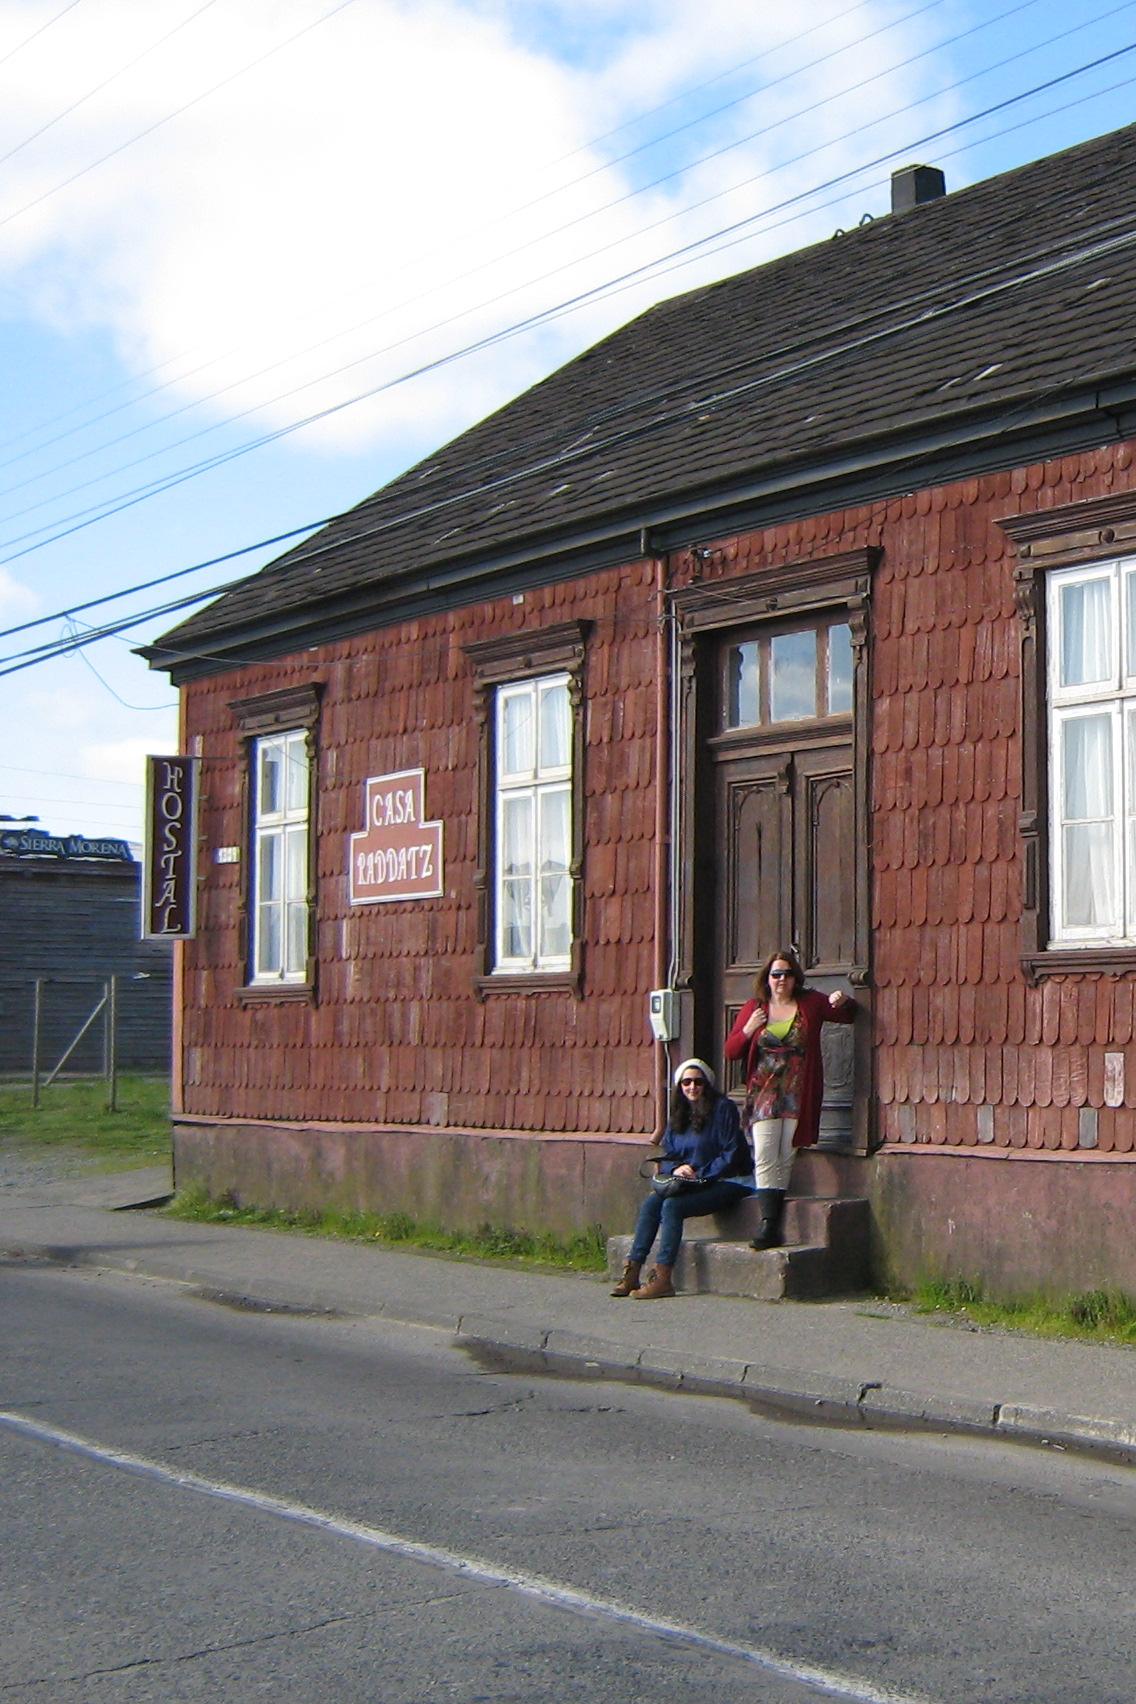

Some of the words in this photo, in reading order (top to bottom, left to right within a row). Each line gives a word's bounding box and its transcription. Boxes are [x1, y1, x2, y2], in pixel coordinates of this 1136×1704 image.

[372, 789, 415, 825] CASA
[20, 836, 66, 854] SIERRA
[69, 841, 128, 855] MORENA
[155, 762, 182, 933] HOSTAL
[357, 844, 433, 885] RADDATZ
